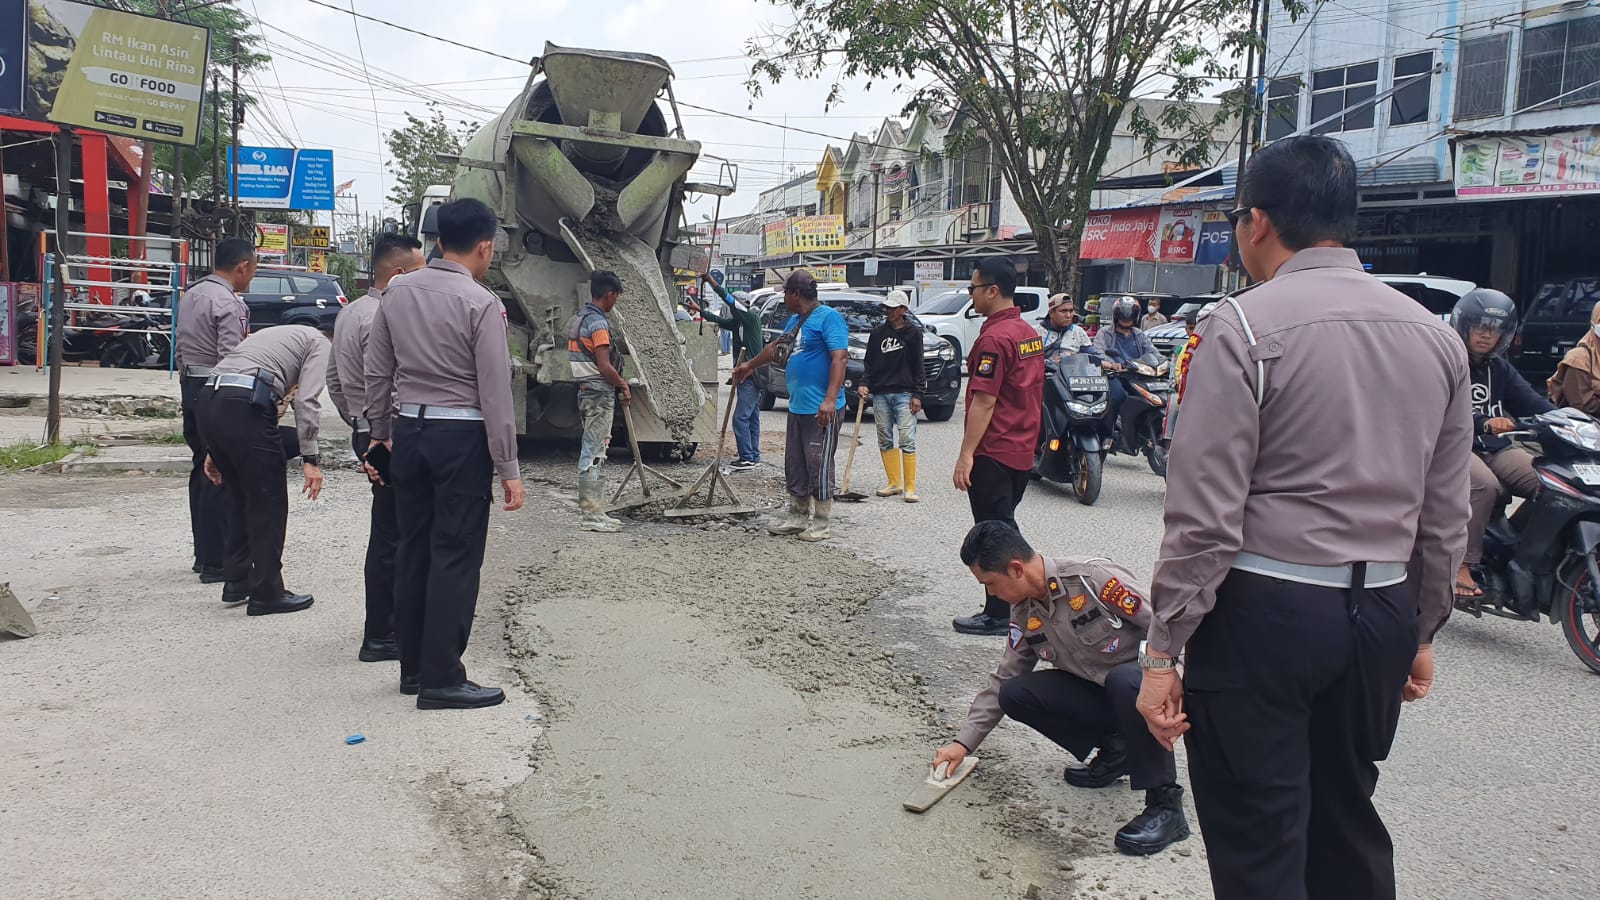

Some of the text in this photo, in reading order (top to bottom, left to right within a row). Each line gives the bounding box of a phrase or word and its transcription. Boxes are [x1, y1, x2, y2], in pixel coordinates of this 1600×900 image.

[102, 32, 189, 59] RM Ikan Asin
[93, 45, 195, 75] Lintau Uni Rina
[110, 73, 176, 94] GO FOOD
[169, 103, 186, 112] PAY
[1526, 184, 1560, 192] PAUS
[1087, 215, 1110, 226] TOKO
[1111, 220, 1155, 234] Indo Jaya
[1200, 231, 1232, 244] POS
[1020, 340, 1043, 355] POLISI
[1102, 579, 1118, 599] POLDA
